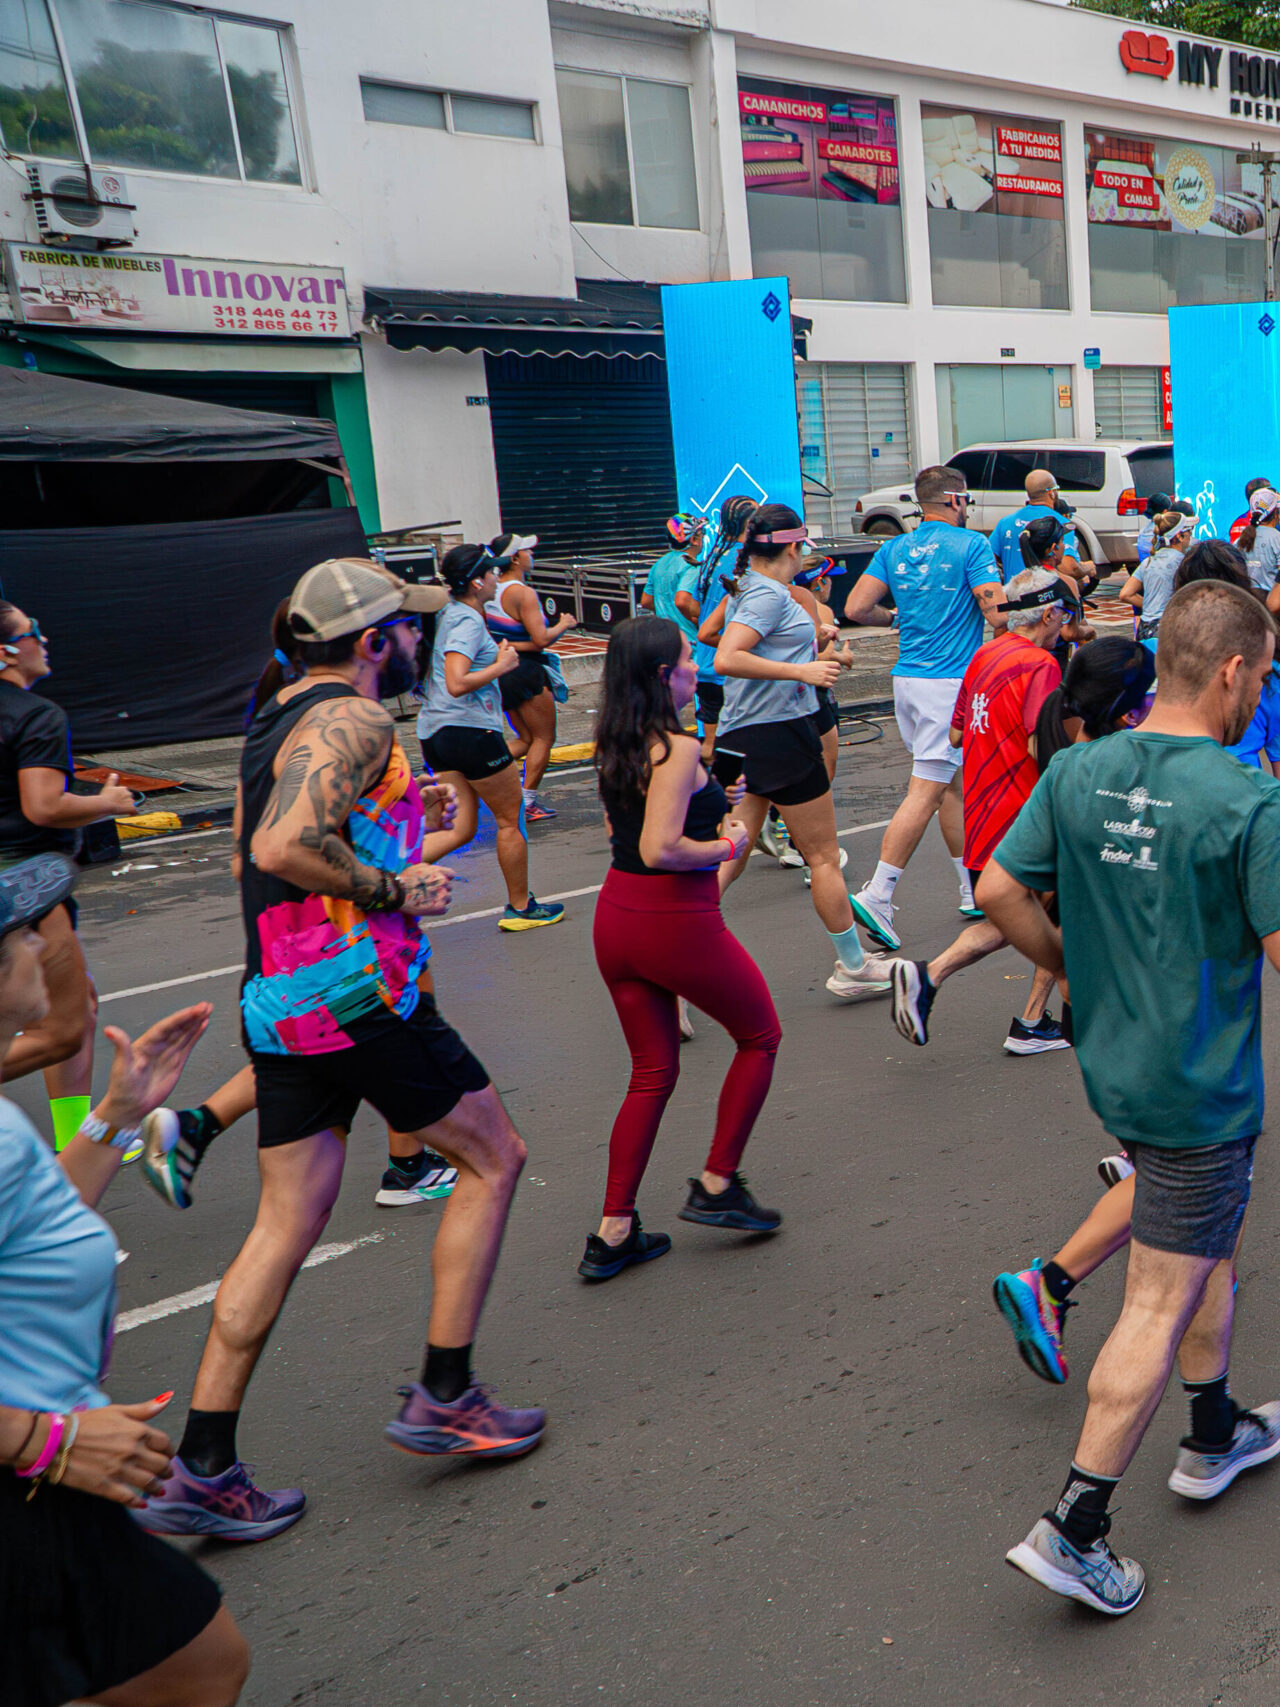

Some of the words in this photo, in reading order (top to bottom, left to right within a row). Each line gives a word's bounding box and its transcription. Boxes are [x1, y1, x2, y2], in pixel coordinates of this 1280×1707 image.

[1178, 40, 1223, 87] MY
[743, 96, 824, 119] CAMANICHOS
[1001, 129, 1060, 147] FABRICAMOS
[827, 143, 892, 163] CAMAROTES
[1001, 143, 1009, 154] A
[1010, 144, 1022, 156] TU
[1024, 146, 1060, 161] MEDIDA
[997, 176, 1062, 194] RESTAURAMOS
[1101, 174, 1128, 188] TODO
[1130, 178, 1144, 190] EN
[1124, 193, 1153, 206] CAMAS
[20, 250, 78, 267] FABRICA
[82, 254, 101, 268] DE
[103, 256, 162, 273] MUEBLES
[163, 258, 344, 305] Innovar
[213, 305, 246, 318] 318
[252, 307, 285, 319] 446
[290, 308, 311, 320] 44
[316, 310, 337, 321] 73
[215, 316, 249, 329] 312
[254, 318, 287, 331] 865
[292, 320, 313, 332] 66
[320, 322, 339, 333] 17
[1037, 590, 1055, 602] 2FIT
